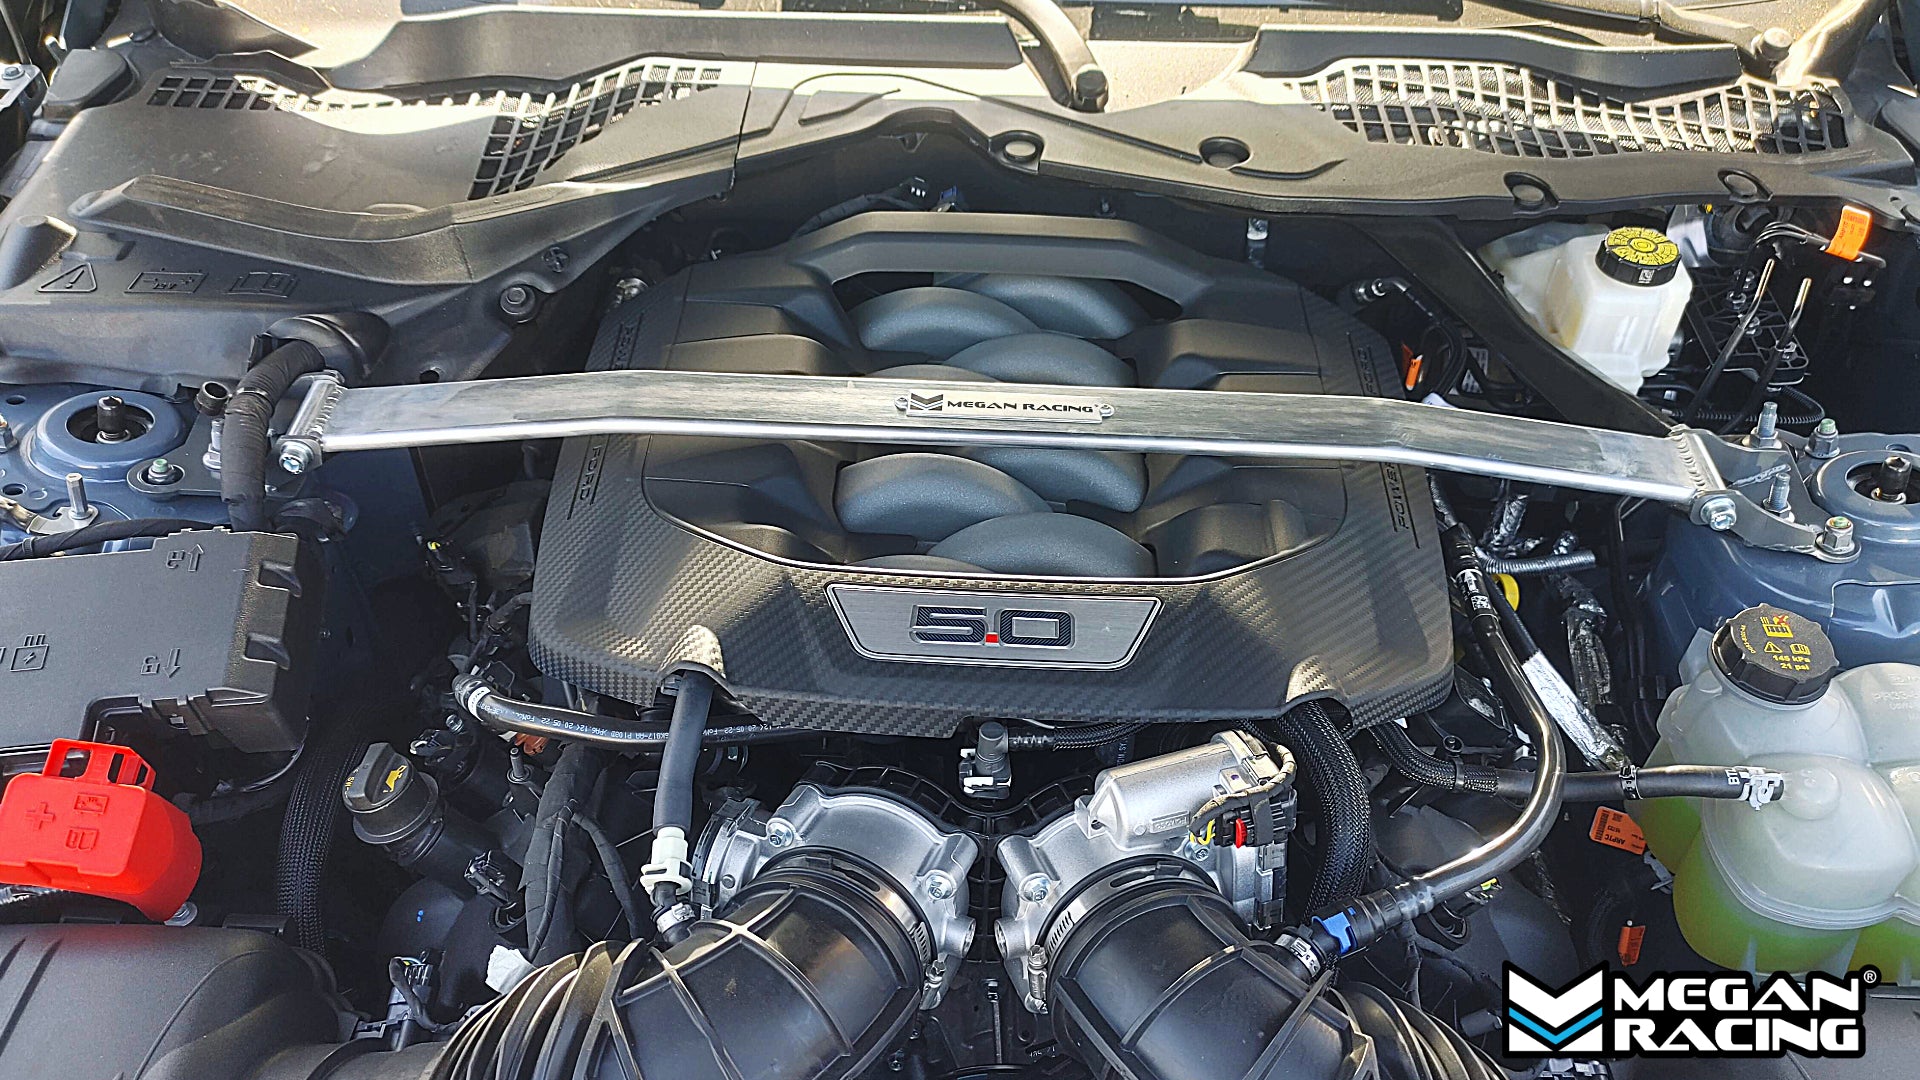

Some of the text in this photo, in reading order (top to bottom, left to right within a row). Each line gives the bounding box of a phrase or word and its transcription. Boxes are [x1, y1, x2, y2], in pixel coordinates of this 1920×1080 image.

[947, 400, 1094, 413] MEGAN RACING
[580, 445, 602, 500] FORD
[909, 604, 1076, 650] 5.0
[1773, 654, 1790, 662] 145
[1780, 662, 1793, 670] 21
